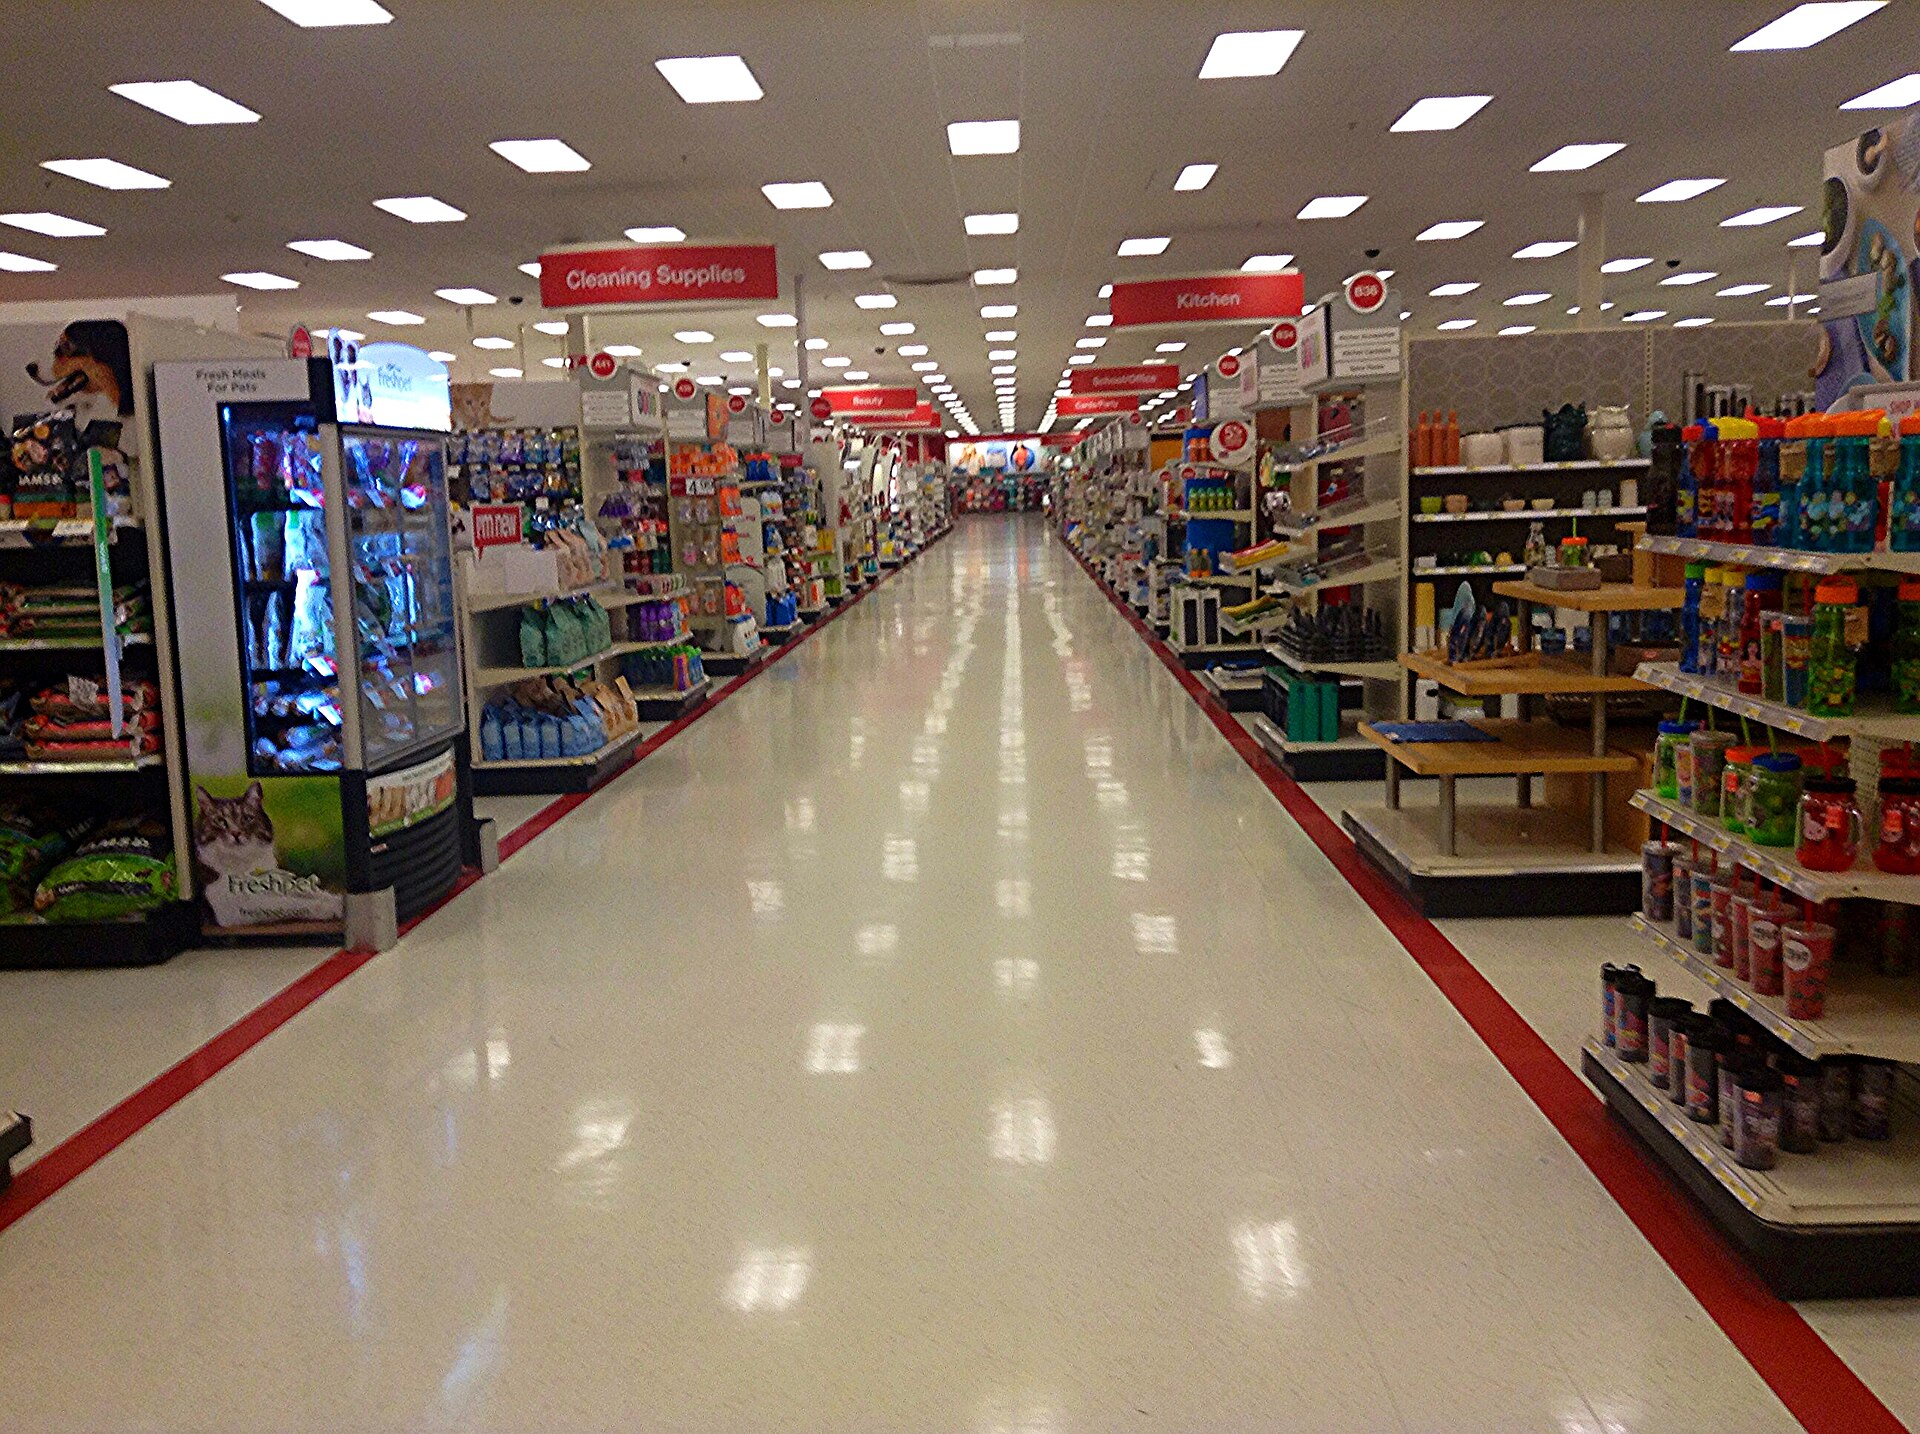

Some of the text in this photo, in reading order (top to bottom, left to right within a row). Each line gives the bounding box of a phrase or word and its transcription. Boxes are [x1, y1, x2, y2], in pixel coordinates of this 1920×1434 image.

[566, 264, 746, 290] Cleaning Supplies
[1177, 292, 1241, 309] Kitchen
[196, 369, 229, 380] Fresh
[207, 382, 258, 393] For Pets
[851, 396, 884, 407] Beauty
